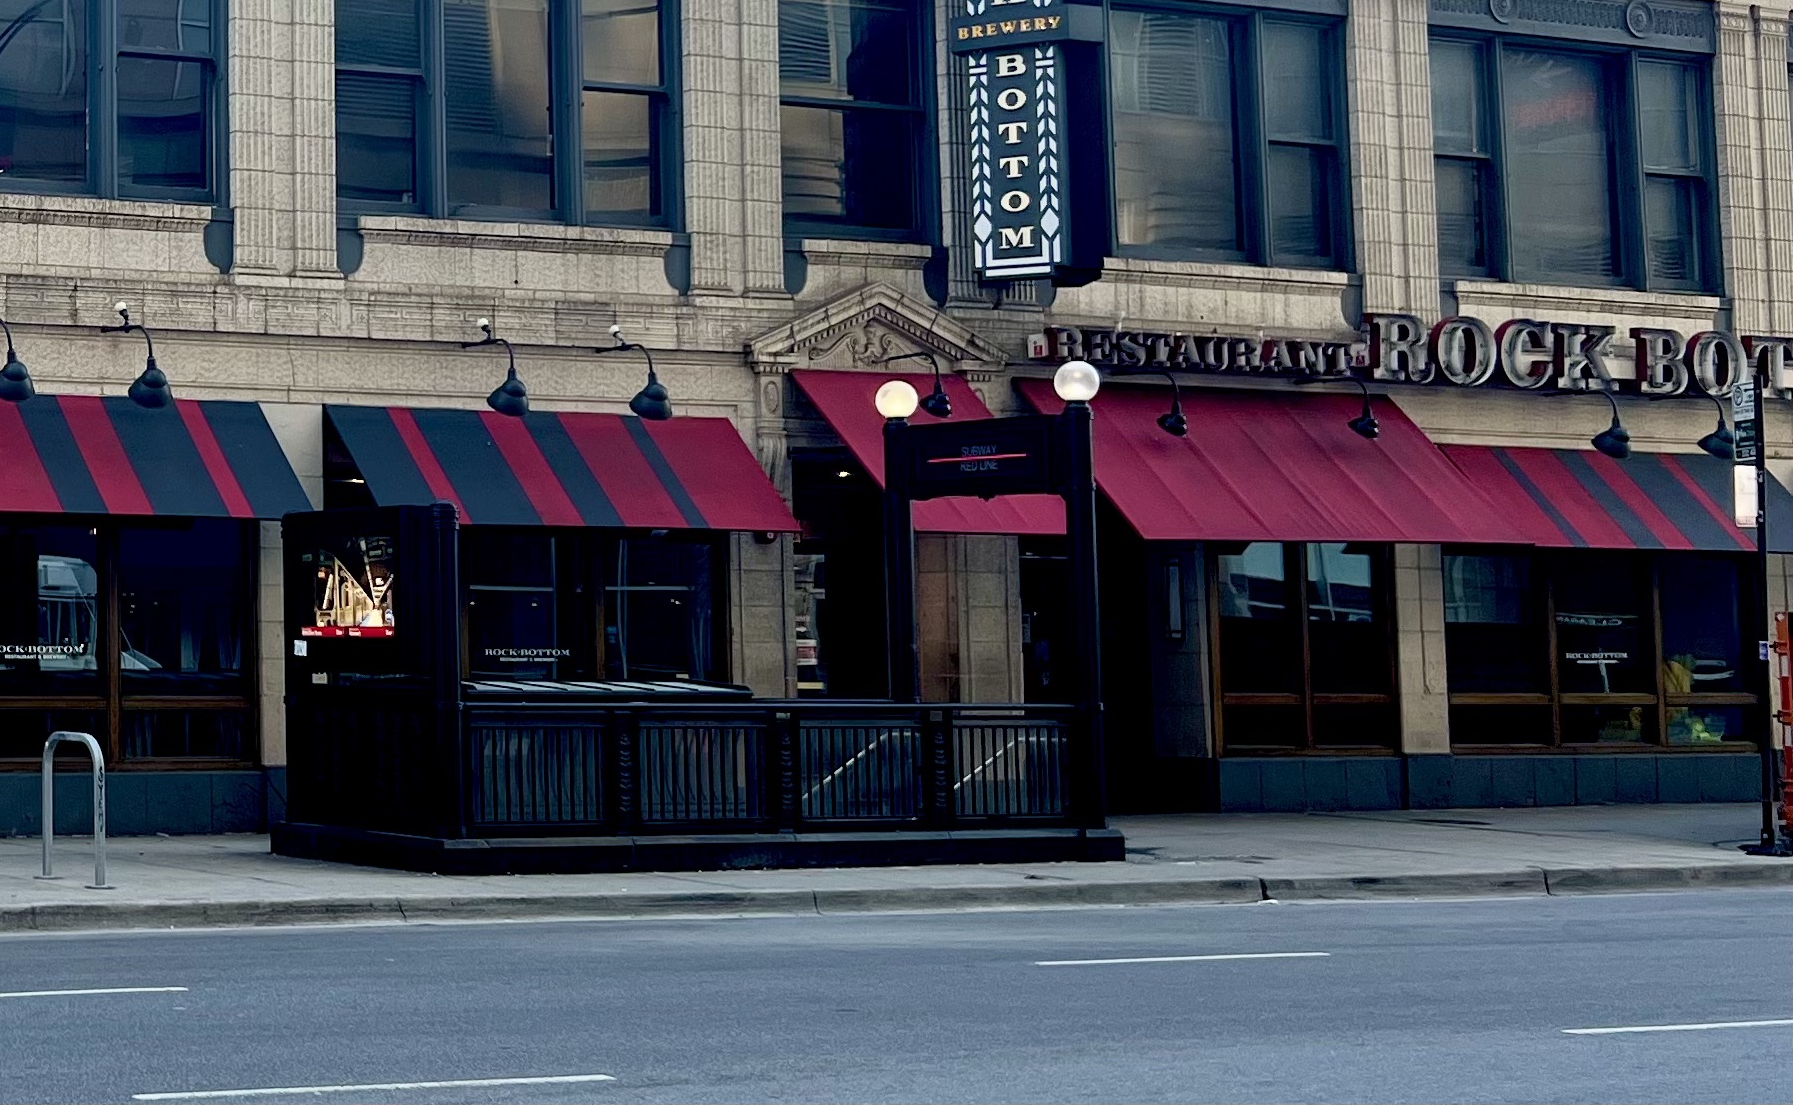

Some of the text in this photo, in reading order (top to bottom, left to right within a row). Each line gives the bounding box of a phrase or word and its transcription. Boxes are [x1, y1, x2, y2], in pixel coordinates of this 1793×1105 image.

[957, 15, 1061, 41] BREWERY
[995, 54, 1035, 250] BOTTOM
[1051, 312, 1793, 400] RESTAURANT ROCK BOT
[961, 445, 997, 457] SUBWAY
[960, 460, 998, 471] RED LINE
